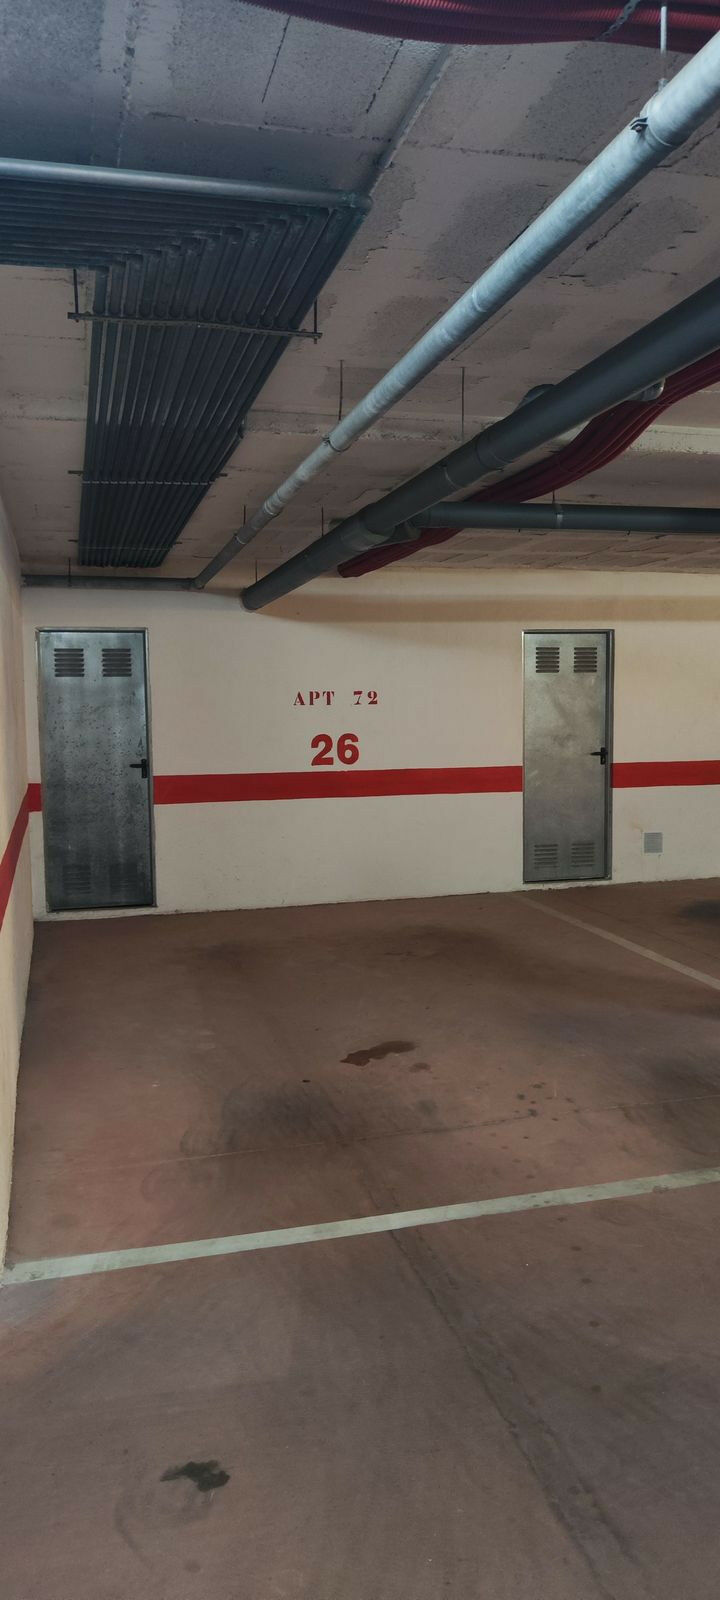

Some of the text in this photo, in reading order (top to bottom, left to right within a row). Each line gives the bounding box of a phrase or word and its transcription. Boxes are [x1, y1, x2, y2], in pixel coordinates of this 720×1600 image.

[293, 690, 379, 706] APT 72
[311, 733, 360, 766] 26
